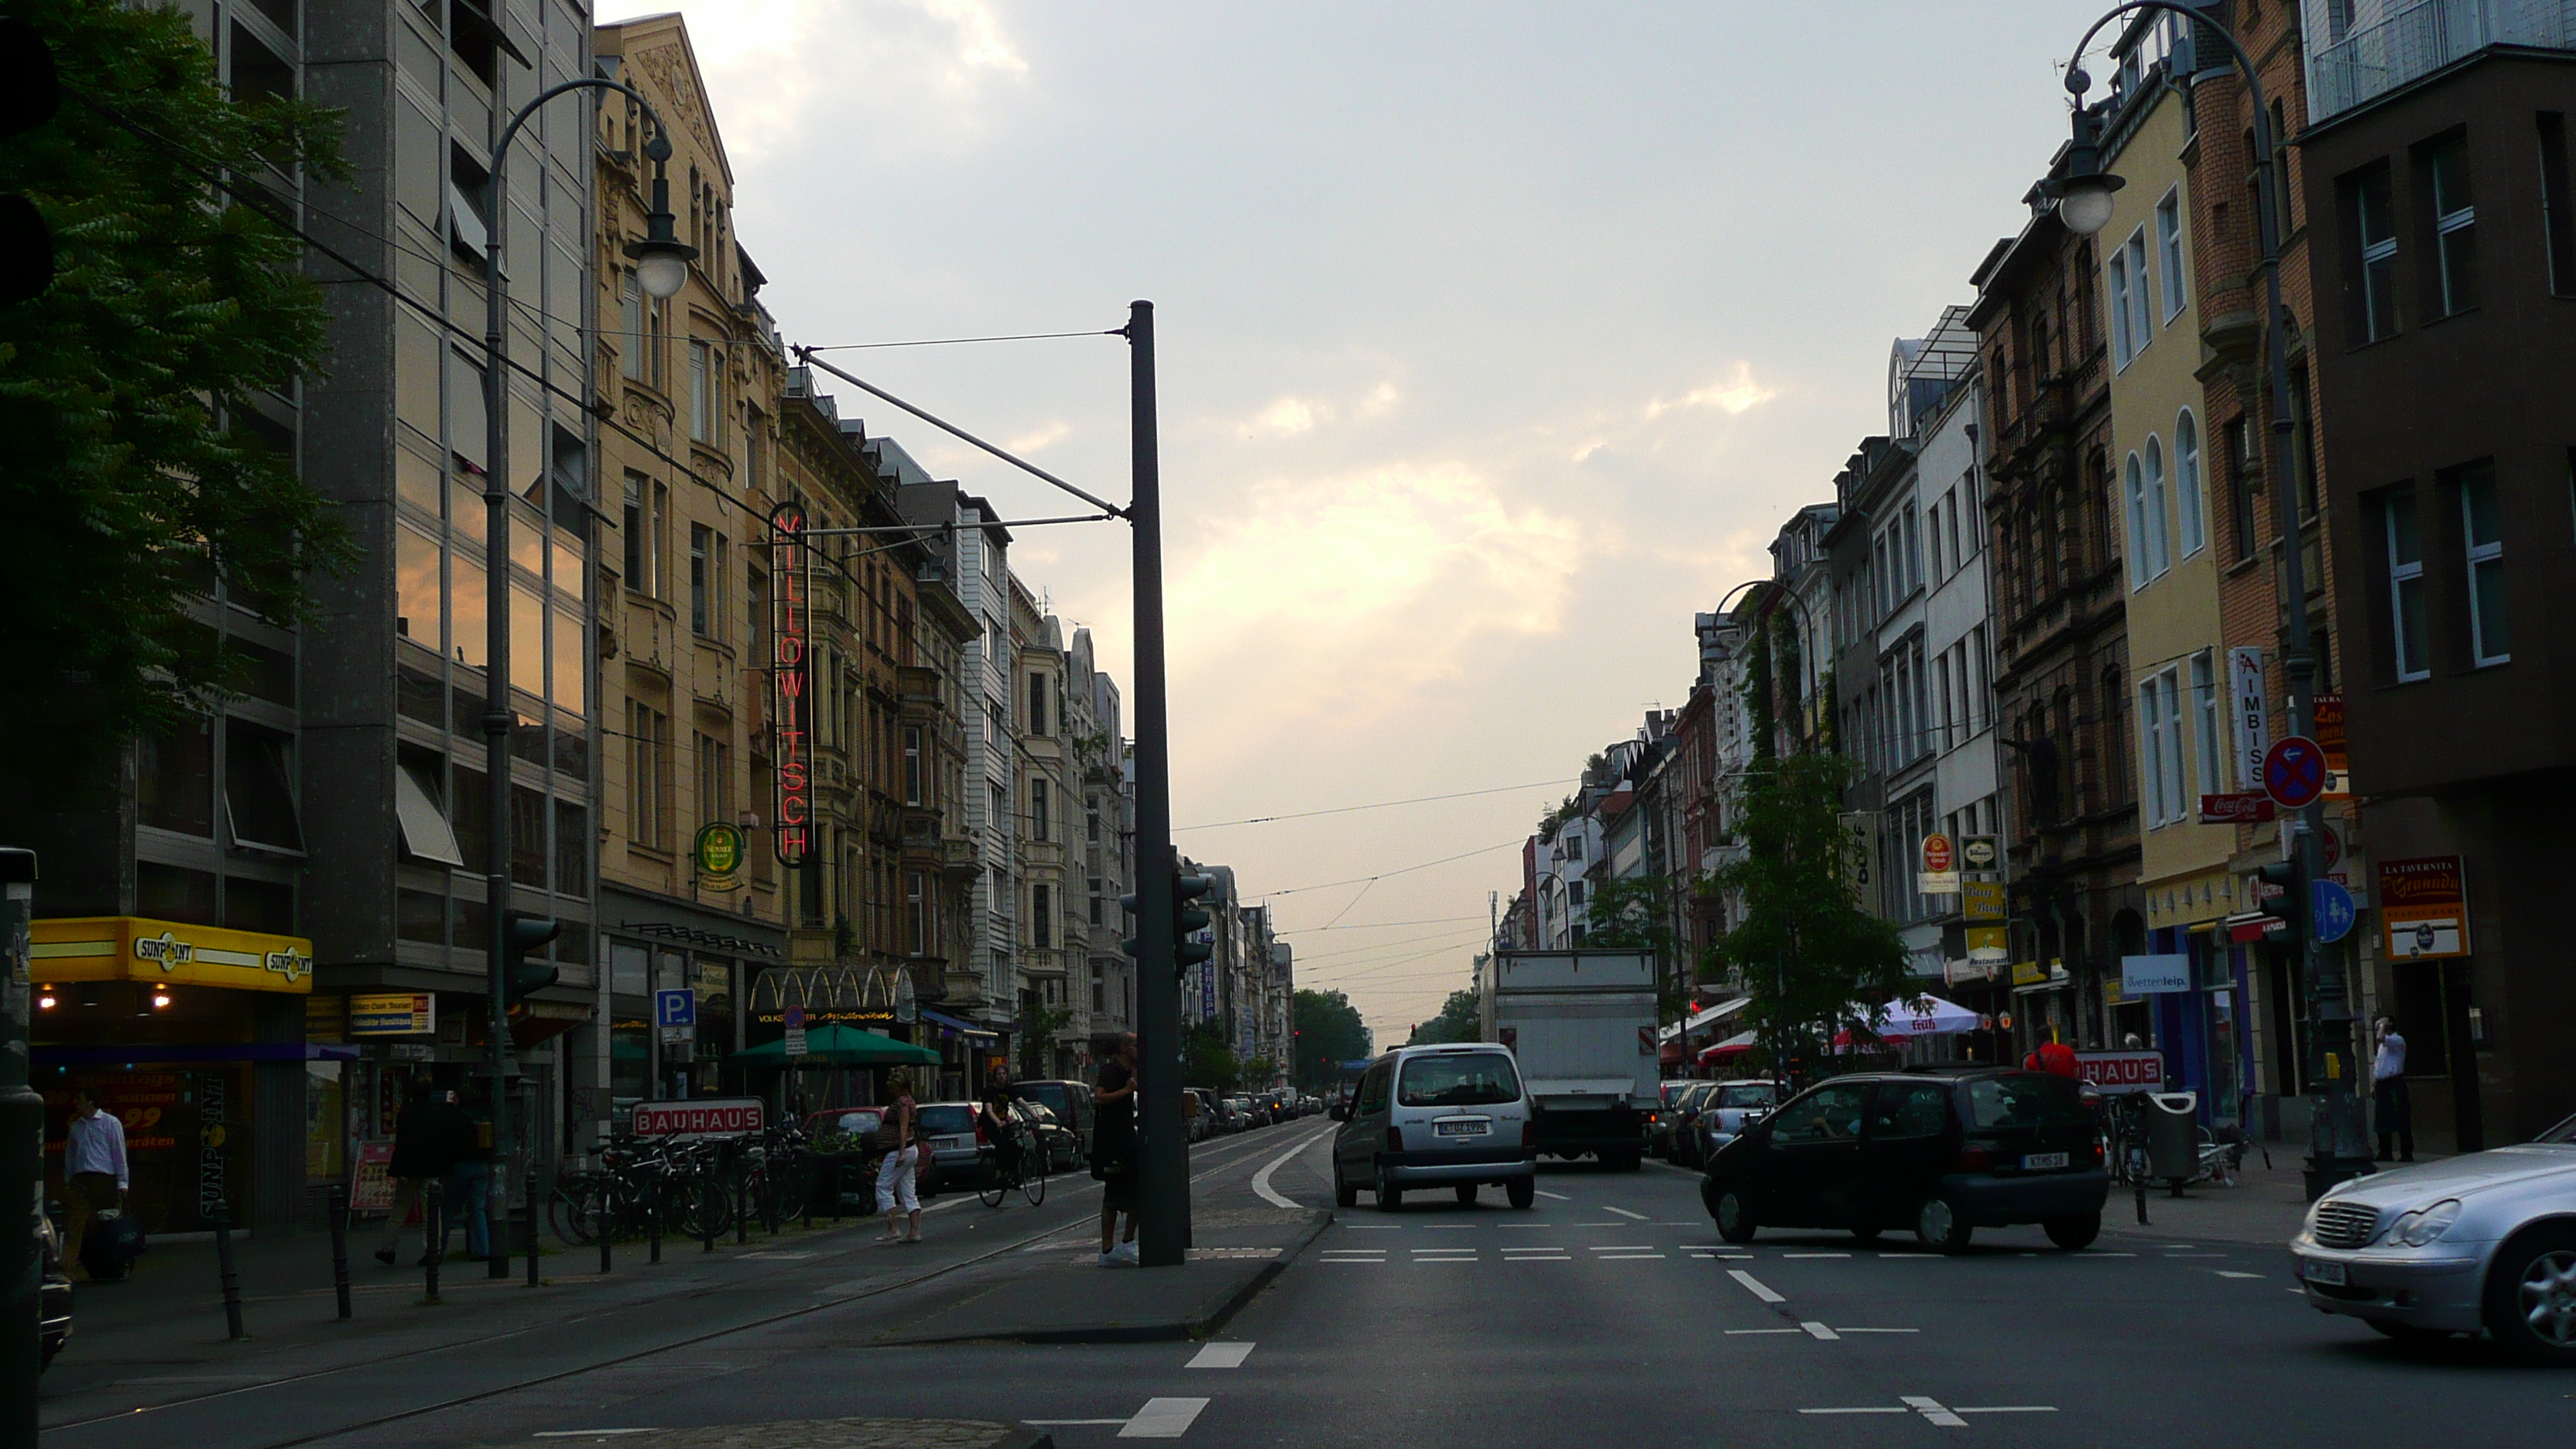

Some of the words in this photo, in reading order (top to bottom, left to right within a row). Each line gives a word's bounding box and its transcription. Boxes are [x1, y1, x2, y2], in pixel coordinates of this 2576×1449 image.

[777, 514, 807, 855] MILLOWITSCH
[2245, 678, 2263, 783] IMBISS
[2385, 865, 2398, 875] LA
[2400, 862, 2453, 873] TAVERNITA
[2392, 872, 2460, 899] Granada
[1969, 957, 2009, 966] Restaurant
[665, 994, 686, 1023] P
[1912, 1018, 1936, 1031] früh
[638, 1110, 761, 1132] BAUHAUS
